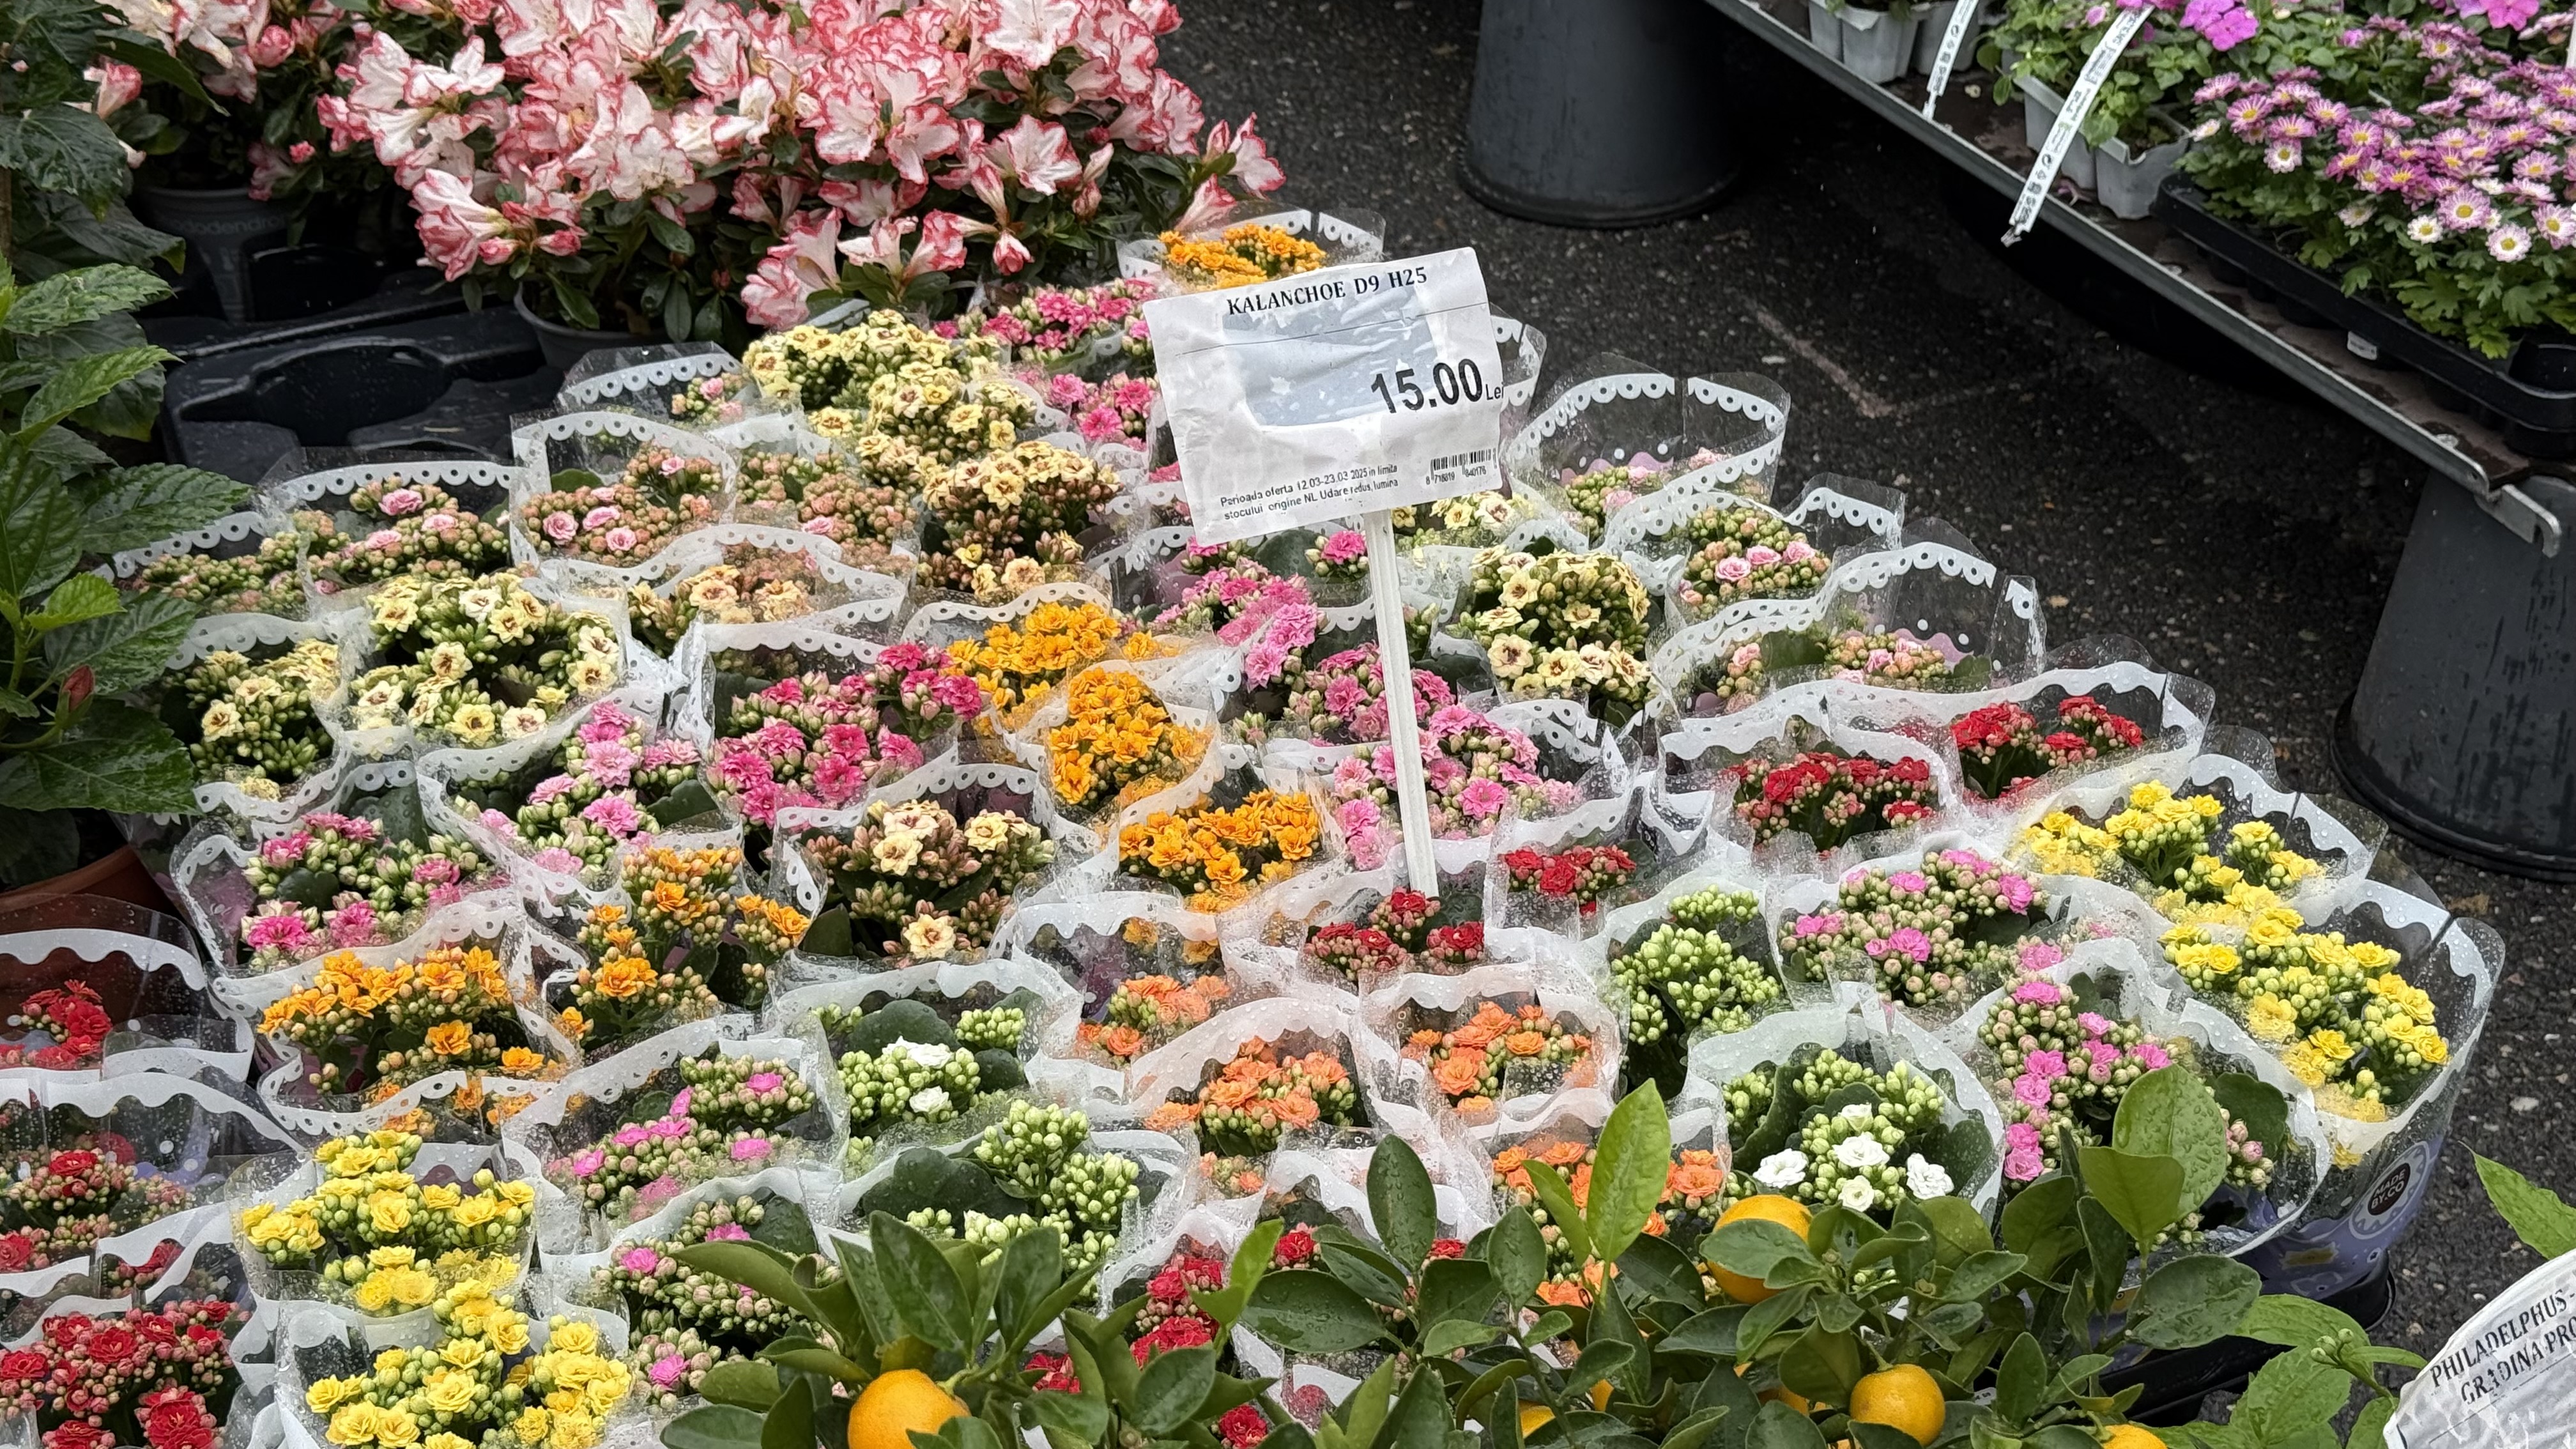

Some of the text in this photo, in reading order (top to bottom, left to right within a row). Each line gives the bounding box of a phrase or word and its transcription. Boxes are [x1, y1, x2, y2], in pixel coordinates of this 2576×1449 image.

[1227, 267, 1427, 314] KALANCHOE D9 H25
[1371, 359, 1504, 413] 15.00 Lei
[1220, 489, 1263, 507] Perioada
[1265, 484, 1294, 498] oferta
[1377, 464, 1398, 475] limita
[1224, 503, 1263, 520] stocului
[1268, 497, 1302, 511] origine
[1304, 493, 1318, 503] NL
[1320, 487, 1349, 500] Udare
[1374, 478, 1399, 490] lumina
[2373, 1169, 2406, 1198] MADE
[2430, 1289, 2567, 1388] PHILADELPHUS
[2461, 1340, 2545, 1405] GRADINA
